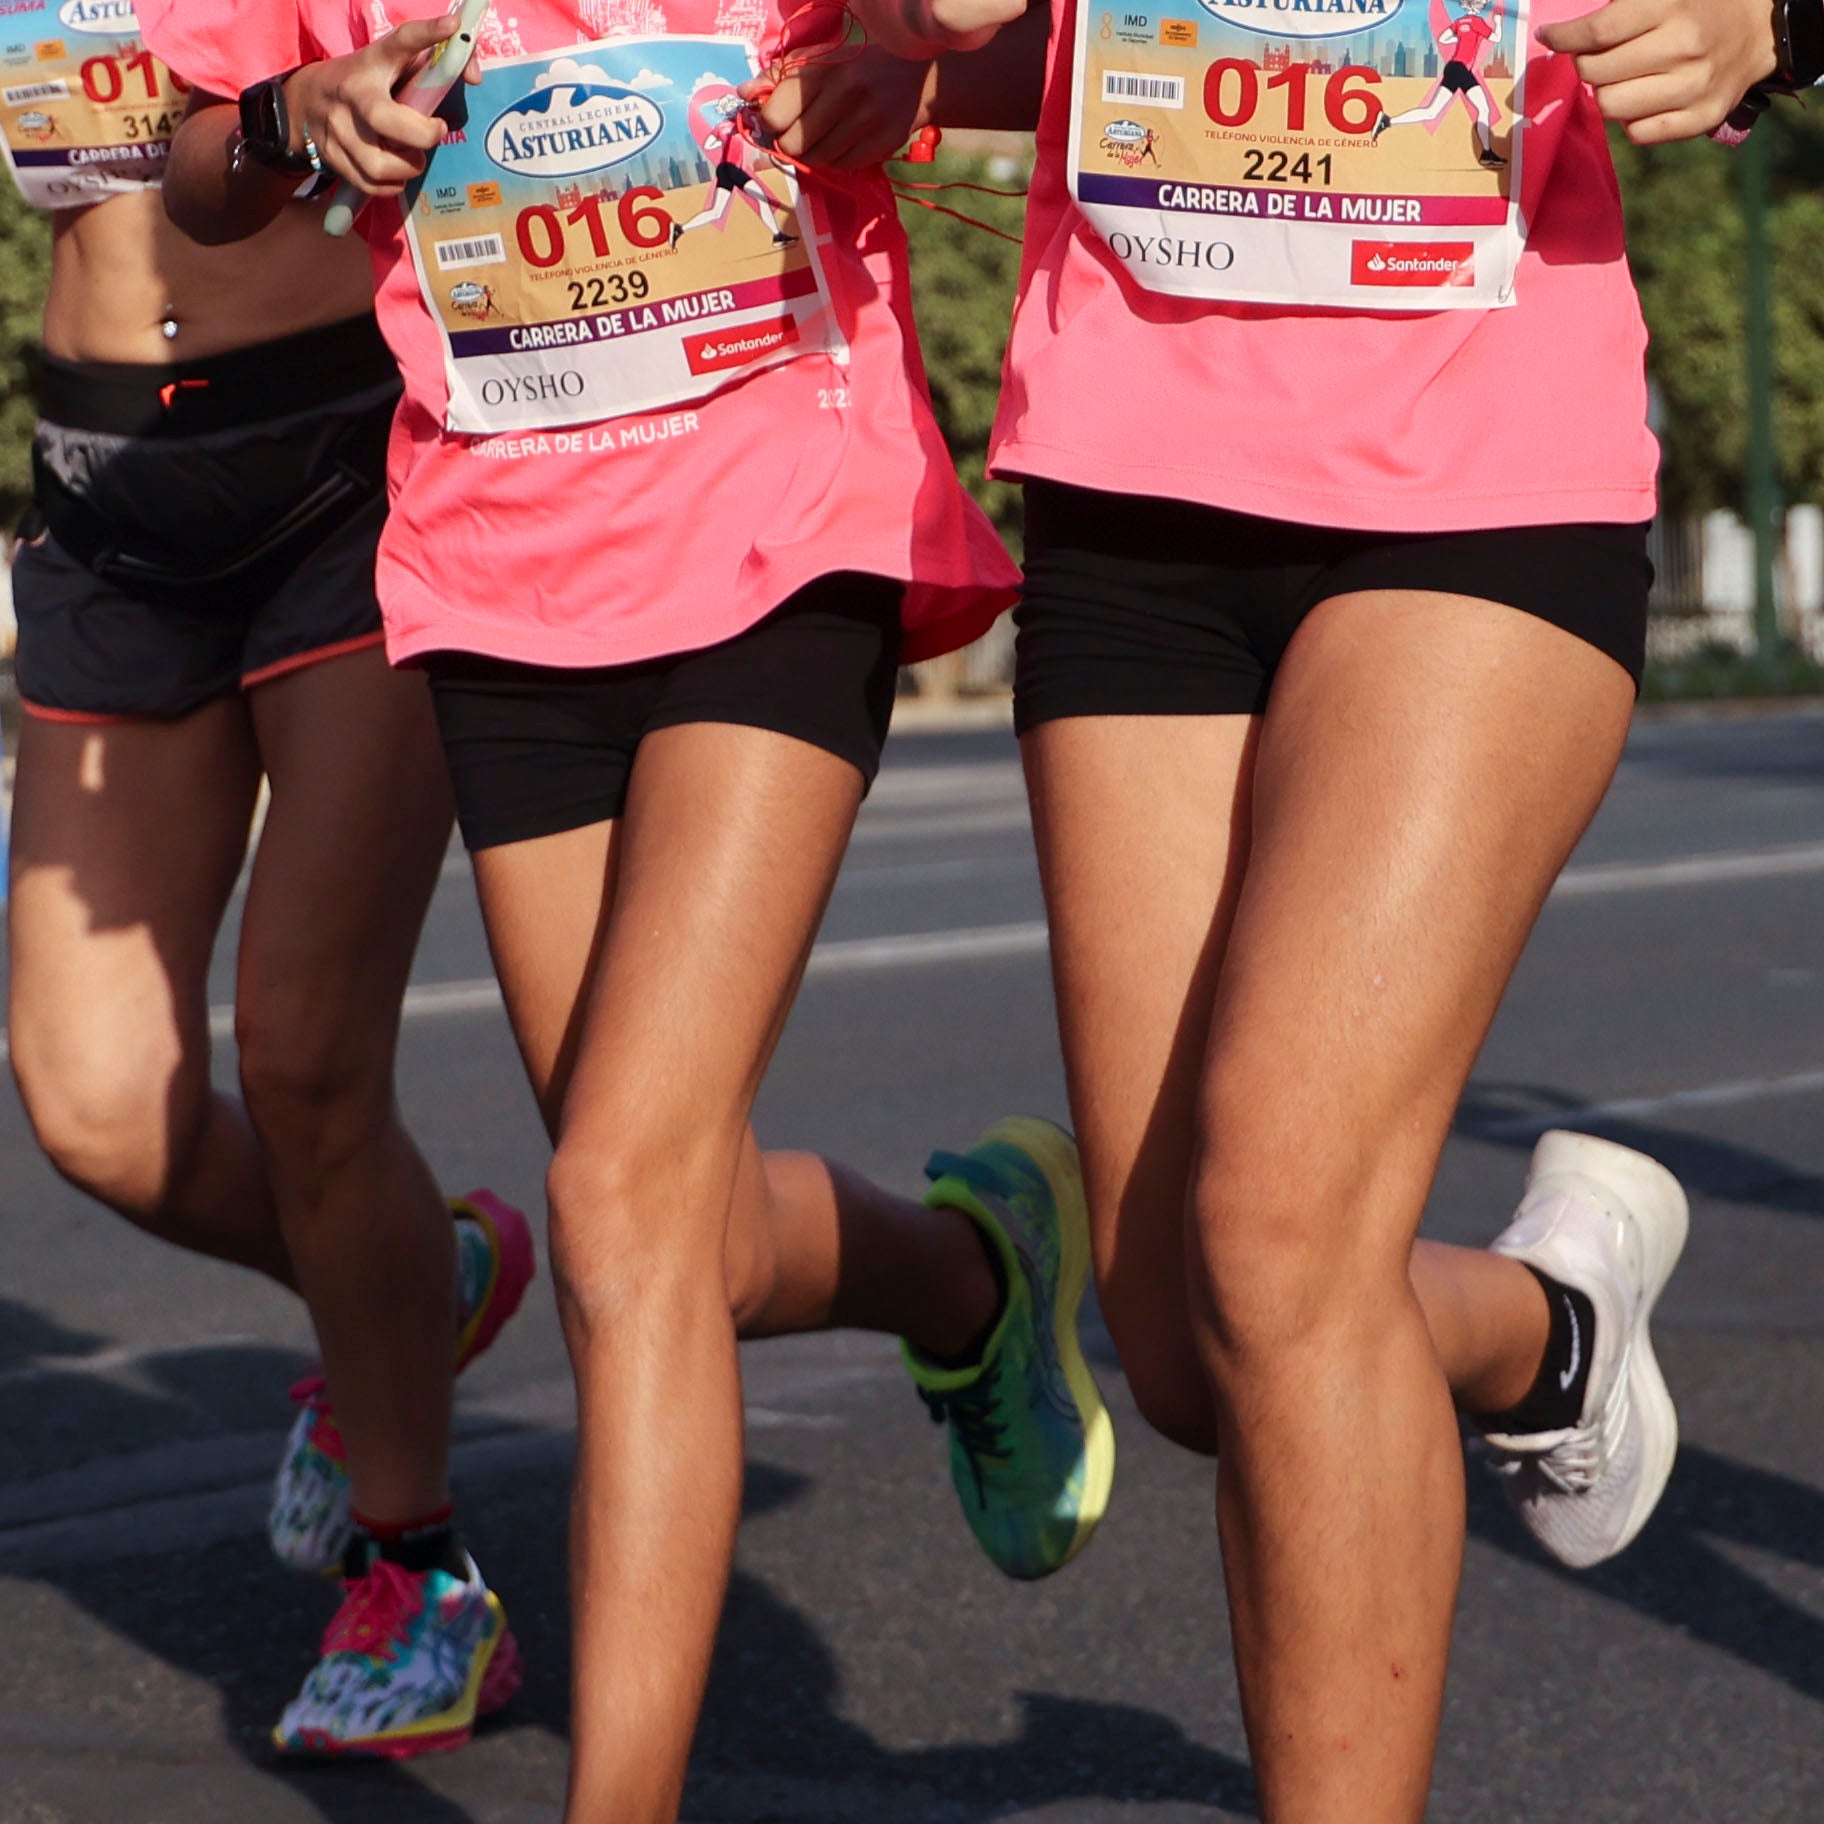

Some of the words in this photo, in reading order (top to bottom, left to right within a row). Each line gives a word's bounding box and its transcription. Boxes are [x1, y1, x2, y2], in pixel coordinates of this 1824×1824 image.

[1124, 14, 1147, 27] IMD
[1203, 57, 1383, 134] 016
[519, 115, 574, 132] CENTRAL
[578, 102, 640, 122] LECHERA
[501, 115, 652, 162] ASTURIANA
[1260, 135, 1315, 146] VIOLENCIA
[1318, 139, 1331, 147] DE
[1243, 149, 1332, 185] 2241
[436, 187, 456, 198] IMD
[1158, 184, 1259, 214] CARRERA
[1267, 193, 1297, 217] DE
[1304, 195, 1333, 219] LA
[1341, 197, 1422, 222] MUJER
[516, 185, 673, 268] 016
[1109, 232, 1235, 270] OYSHO
[1387, 257, 1458, 273] Santander
[568, 270, 649, 310] 2239
[509, 320, 593, 349] CARRERA
[598, 314, 625, 337] DE
[629, 307, 658, 332] LA
[662, 290, 736, 324] MUJER
[717, 332, 784, 357] Santander
[482, 371, 585, 405] OYSHO
[470, 435, 551, 460] CARRERA
[555, 434, 583, 454] DE
[589, 430, 615, 451] LA
[621, 412, 700, 448] MUJER
